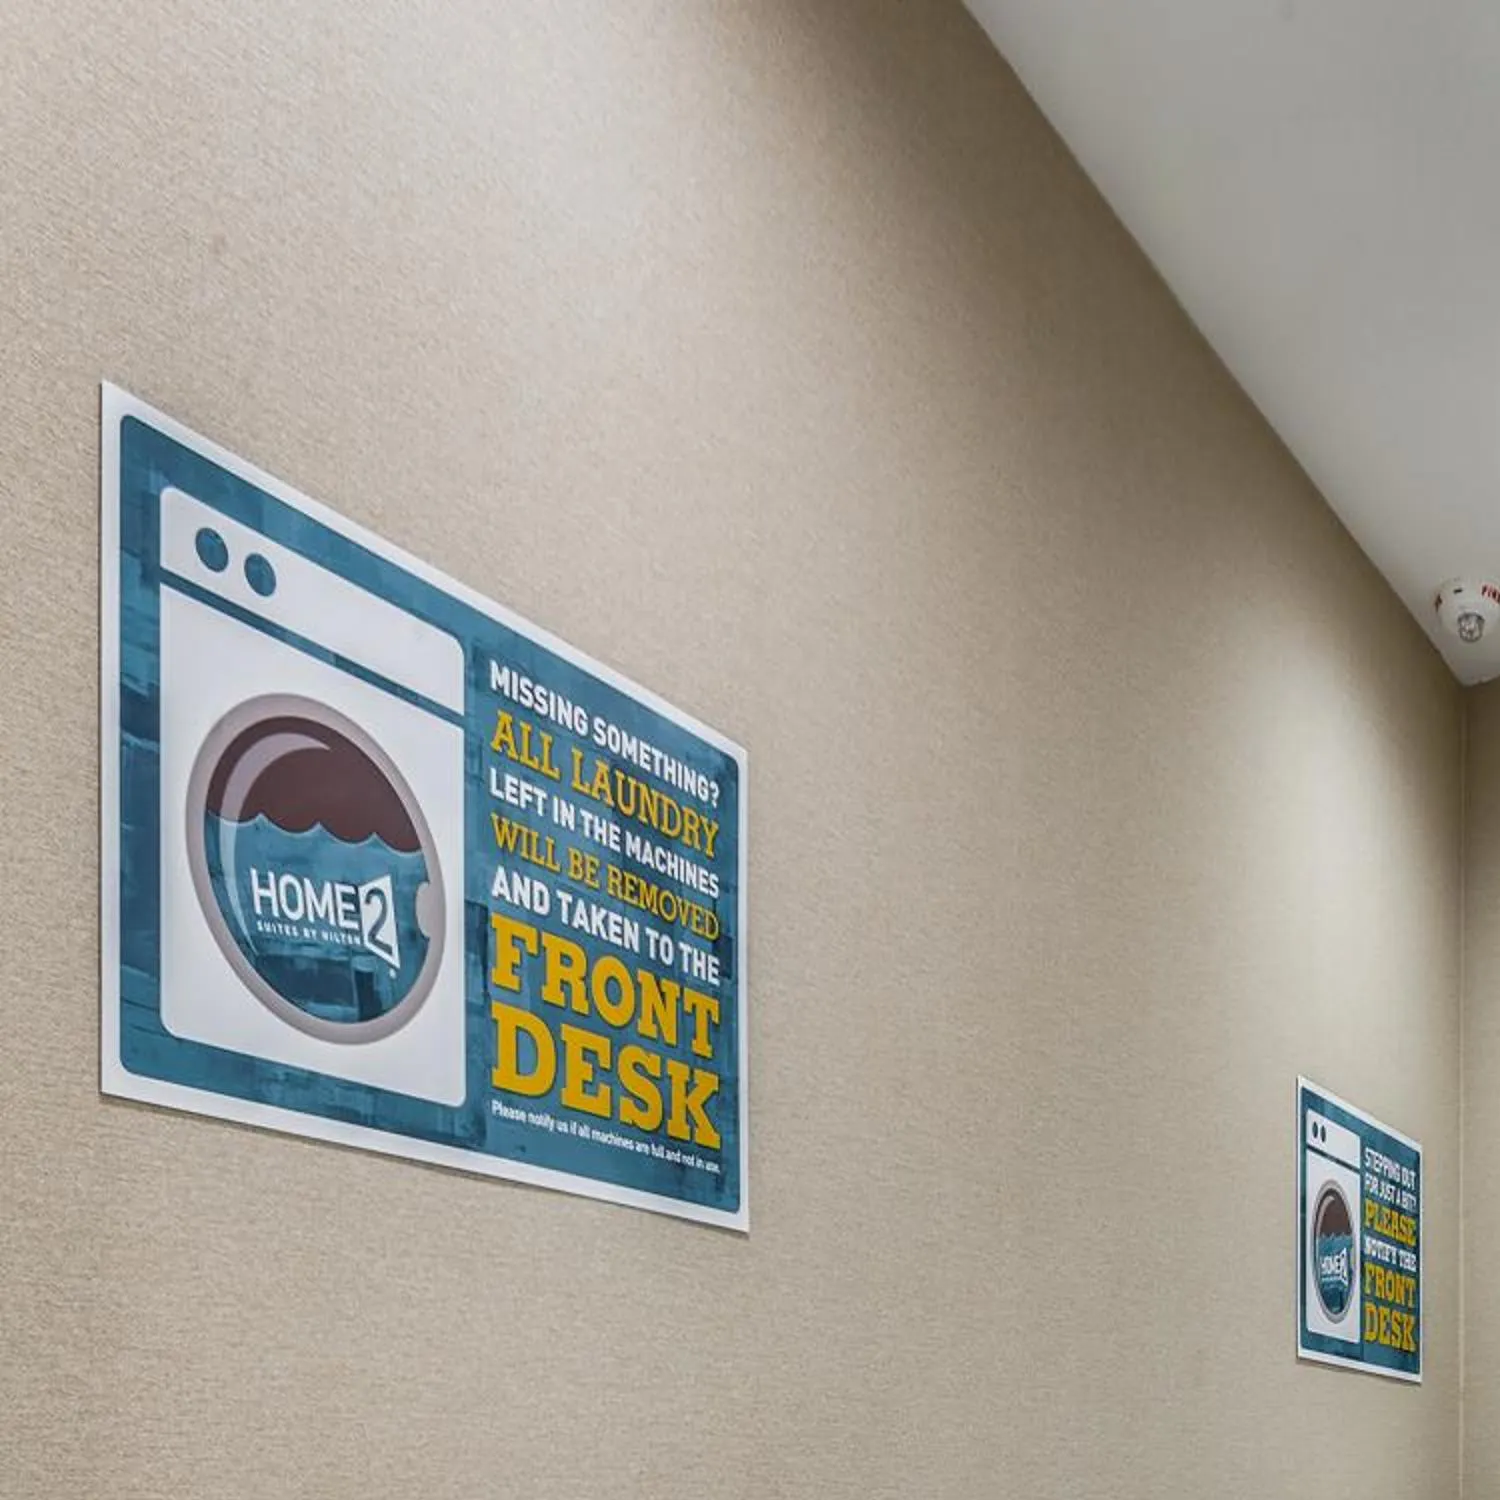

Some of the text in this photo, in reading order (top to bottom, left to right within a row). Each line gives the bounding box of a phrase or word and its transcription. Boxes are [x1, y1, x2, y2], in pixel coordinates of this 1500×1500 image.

[489, 660, 720, 807] MISSING SOMETHING?
[490, 709, 718, 857] ALL LAUNDRY
[489, 767, 719, 899] LEFT IN THE MACHINES
[490, 812, 719, 941] WILL BE REMOVED
[491, 912, 719, 1058] FRONT
[492, 866, 720, 986] AND TAKEN TO THE
[491, 1001, 720, 1149] DESK
[491, 1099, 526, 1123] Please
[528, 1113, 554, 1132] notify
[556, 1120, 568, 1133] us
[570, 1121, 577, 1135] if
[591, 1129, 635, 1150] machines
[1364, 1200, 1416, 1247] PLEASE
[1364, 1262, 1416, 1308] FRONT
[1364, 1301, 1416, 1352] DESK
